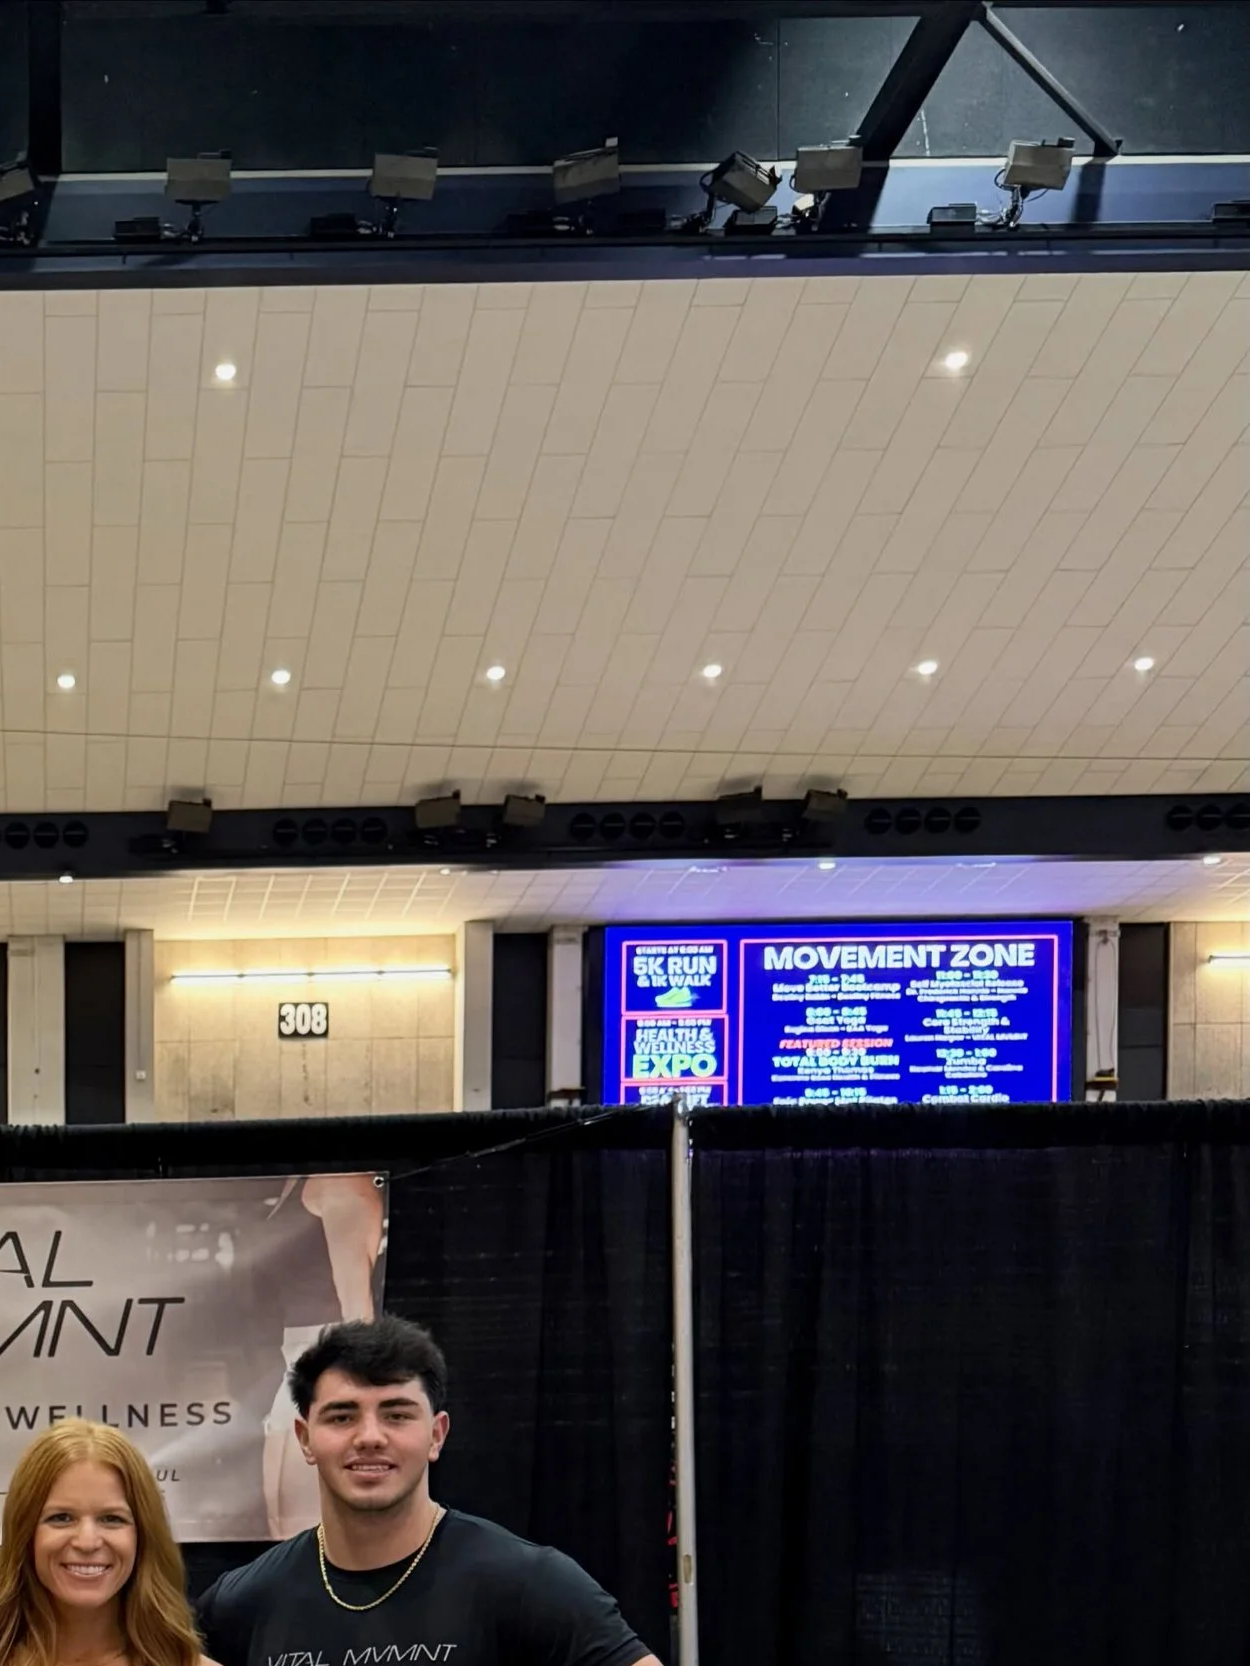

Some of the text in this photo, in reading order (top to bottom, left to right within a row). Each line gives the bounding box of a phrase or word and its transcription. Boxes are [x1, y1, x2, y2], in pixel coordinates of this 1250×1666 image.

[764, 943, 1035, 970] MOVEMENT ZONE
[634, 956, 716, 975] 5K RUN
[637, 975, 711, 987] & 1K WALK
[280, 1005, 327, 1036] 308
[636, 1027, 713, 1042] HEALTH &
[634, 1041, 715, 1054] WELLNESS
[780, 1039, 893, 1048] FEATURED SESSION
[633, 1054, 717, 1078] EXPO
[772, 1057, 817, 1067] TOTAL
[819, 1056, 858, 1066] BODY
[342, 1644, 457, 1666] MVMNT
